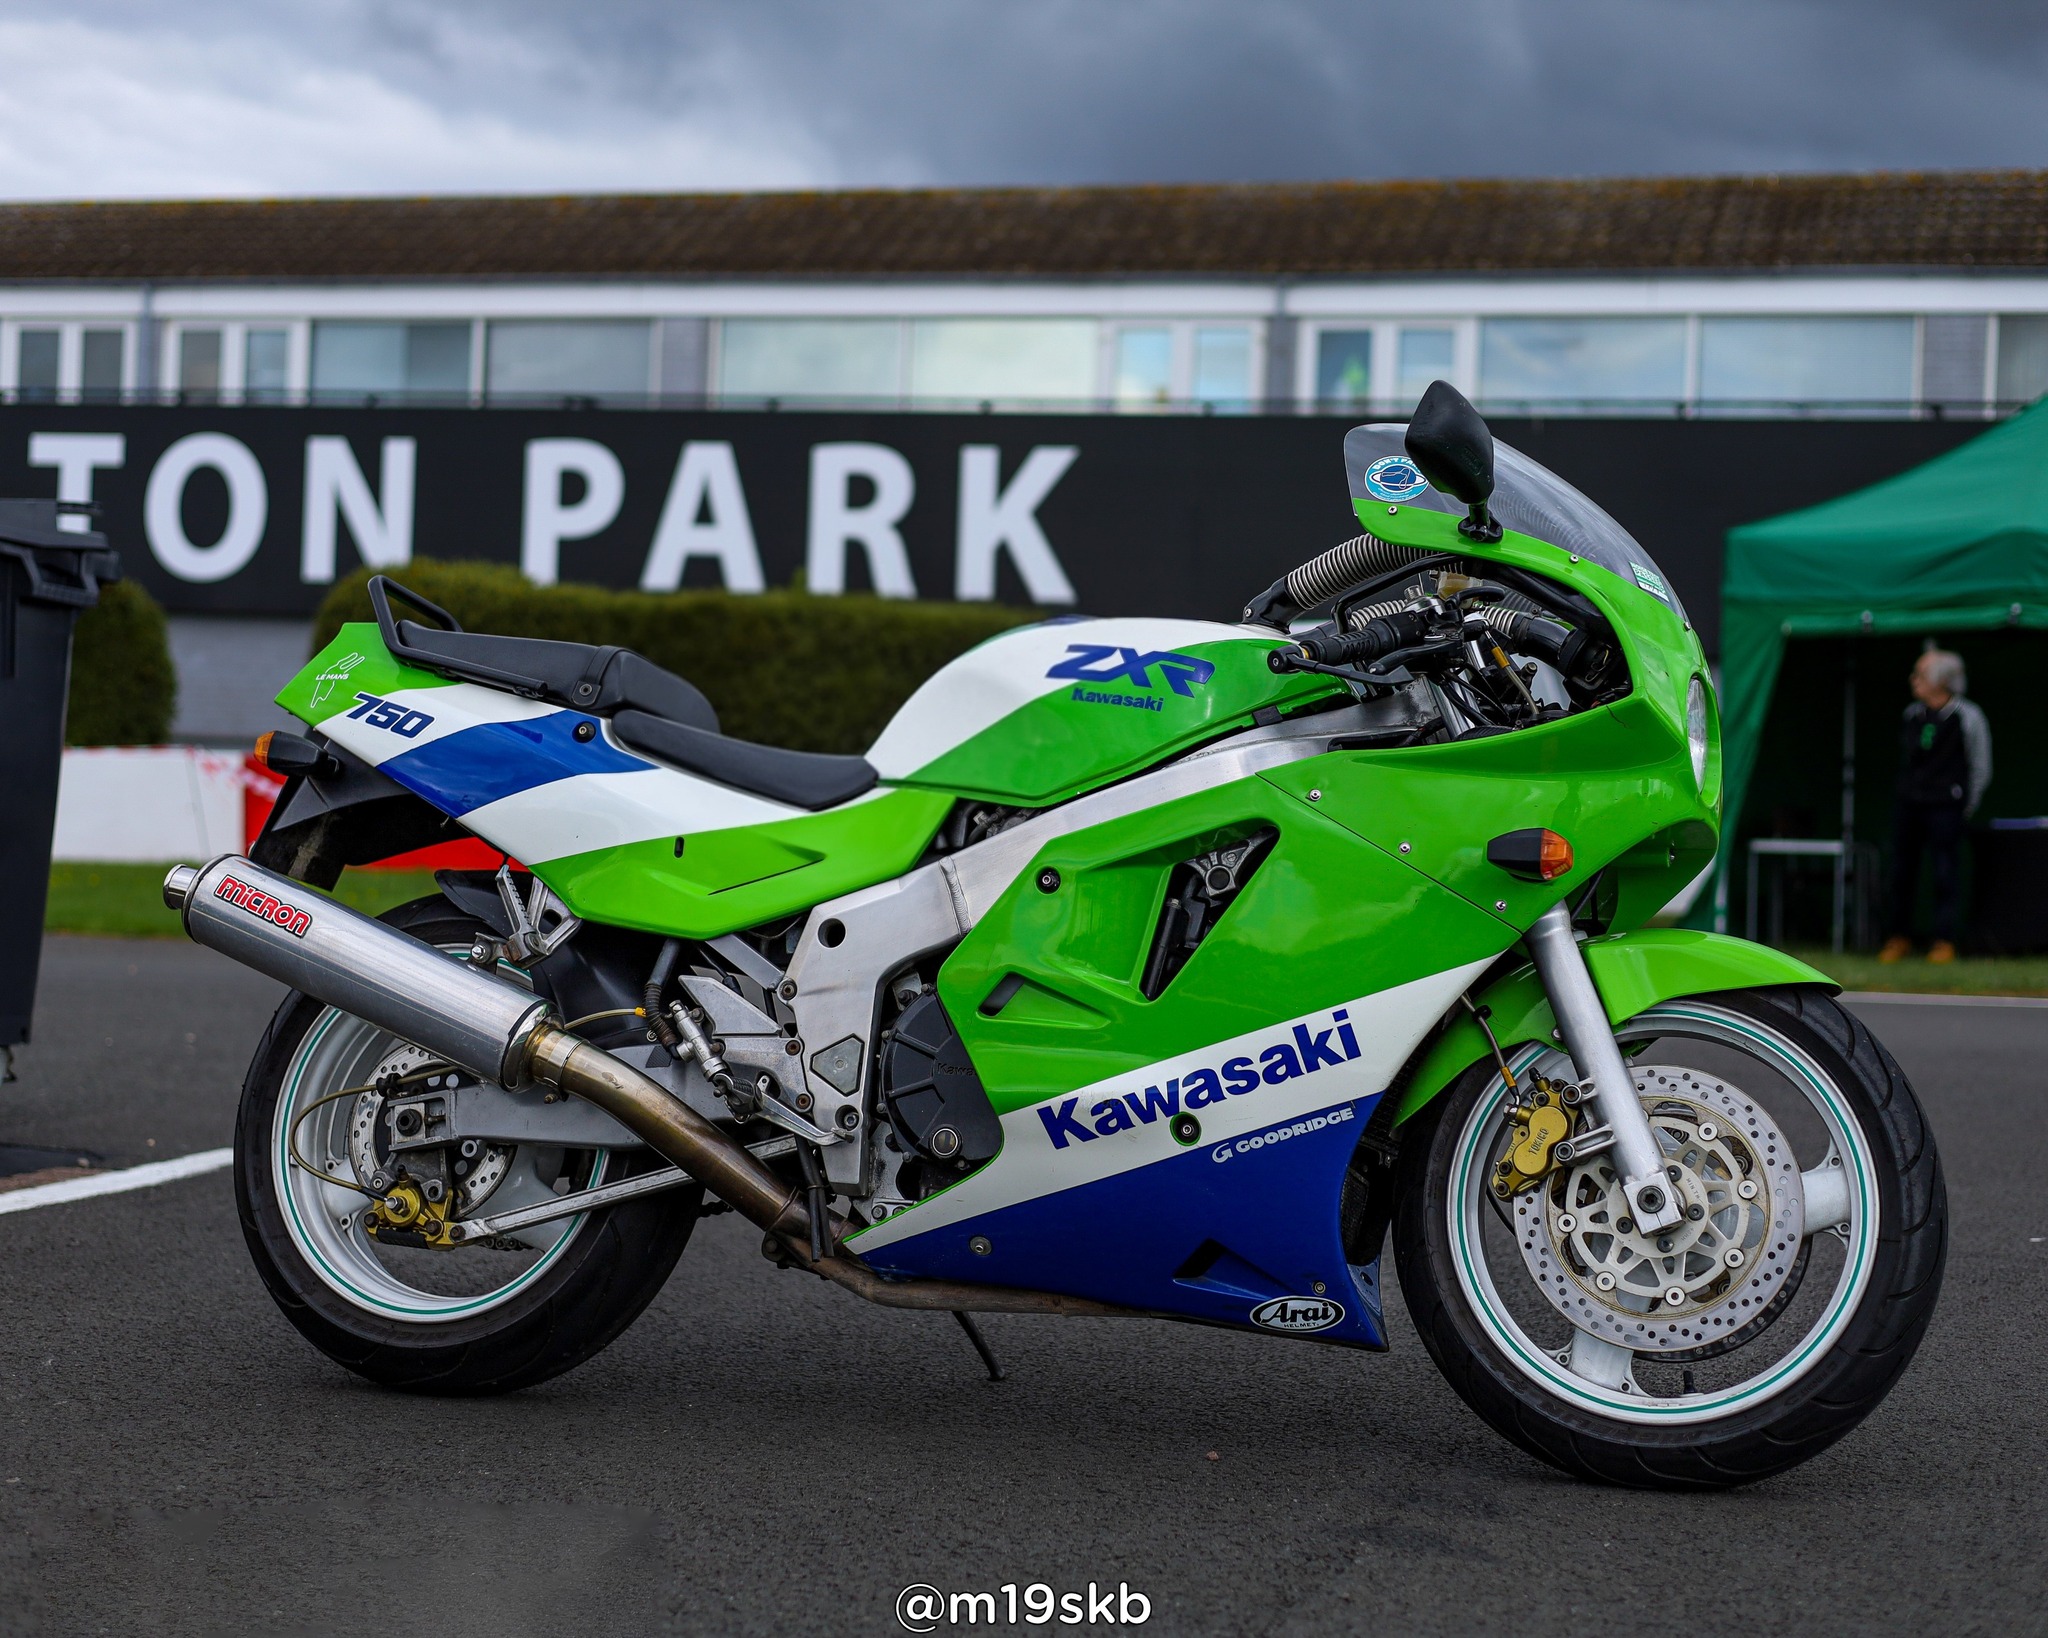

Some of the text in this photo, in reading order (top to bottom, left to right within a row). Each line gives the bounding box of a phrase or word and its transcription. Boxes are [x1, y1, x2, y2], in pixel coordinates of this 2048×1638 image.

[28, 432, 1081, 605] TON PARK
[325, 673, 350, 681] MANS
[1045, 644, 1215, 698] ZXR
[346, 692, 436, 739] 750
[1071, 687, 1164, 712] Kawasaki
[1036, 1008, 1362, 1150] Kawasaki
[1235, 1107, 1355, 1153] GOODRIDGE
[1528, 1128, 1550, 1155] TOKICO
[1260, 1302, 1333, 1324] Arai
